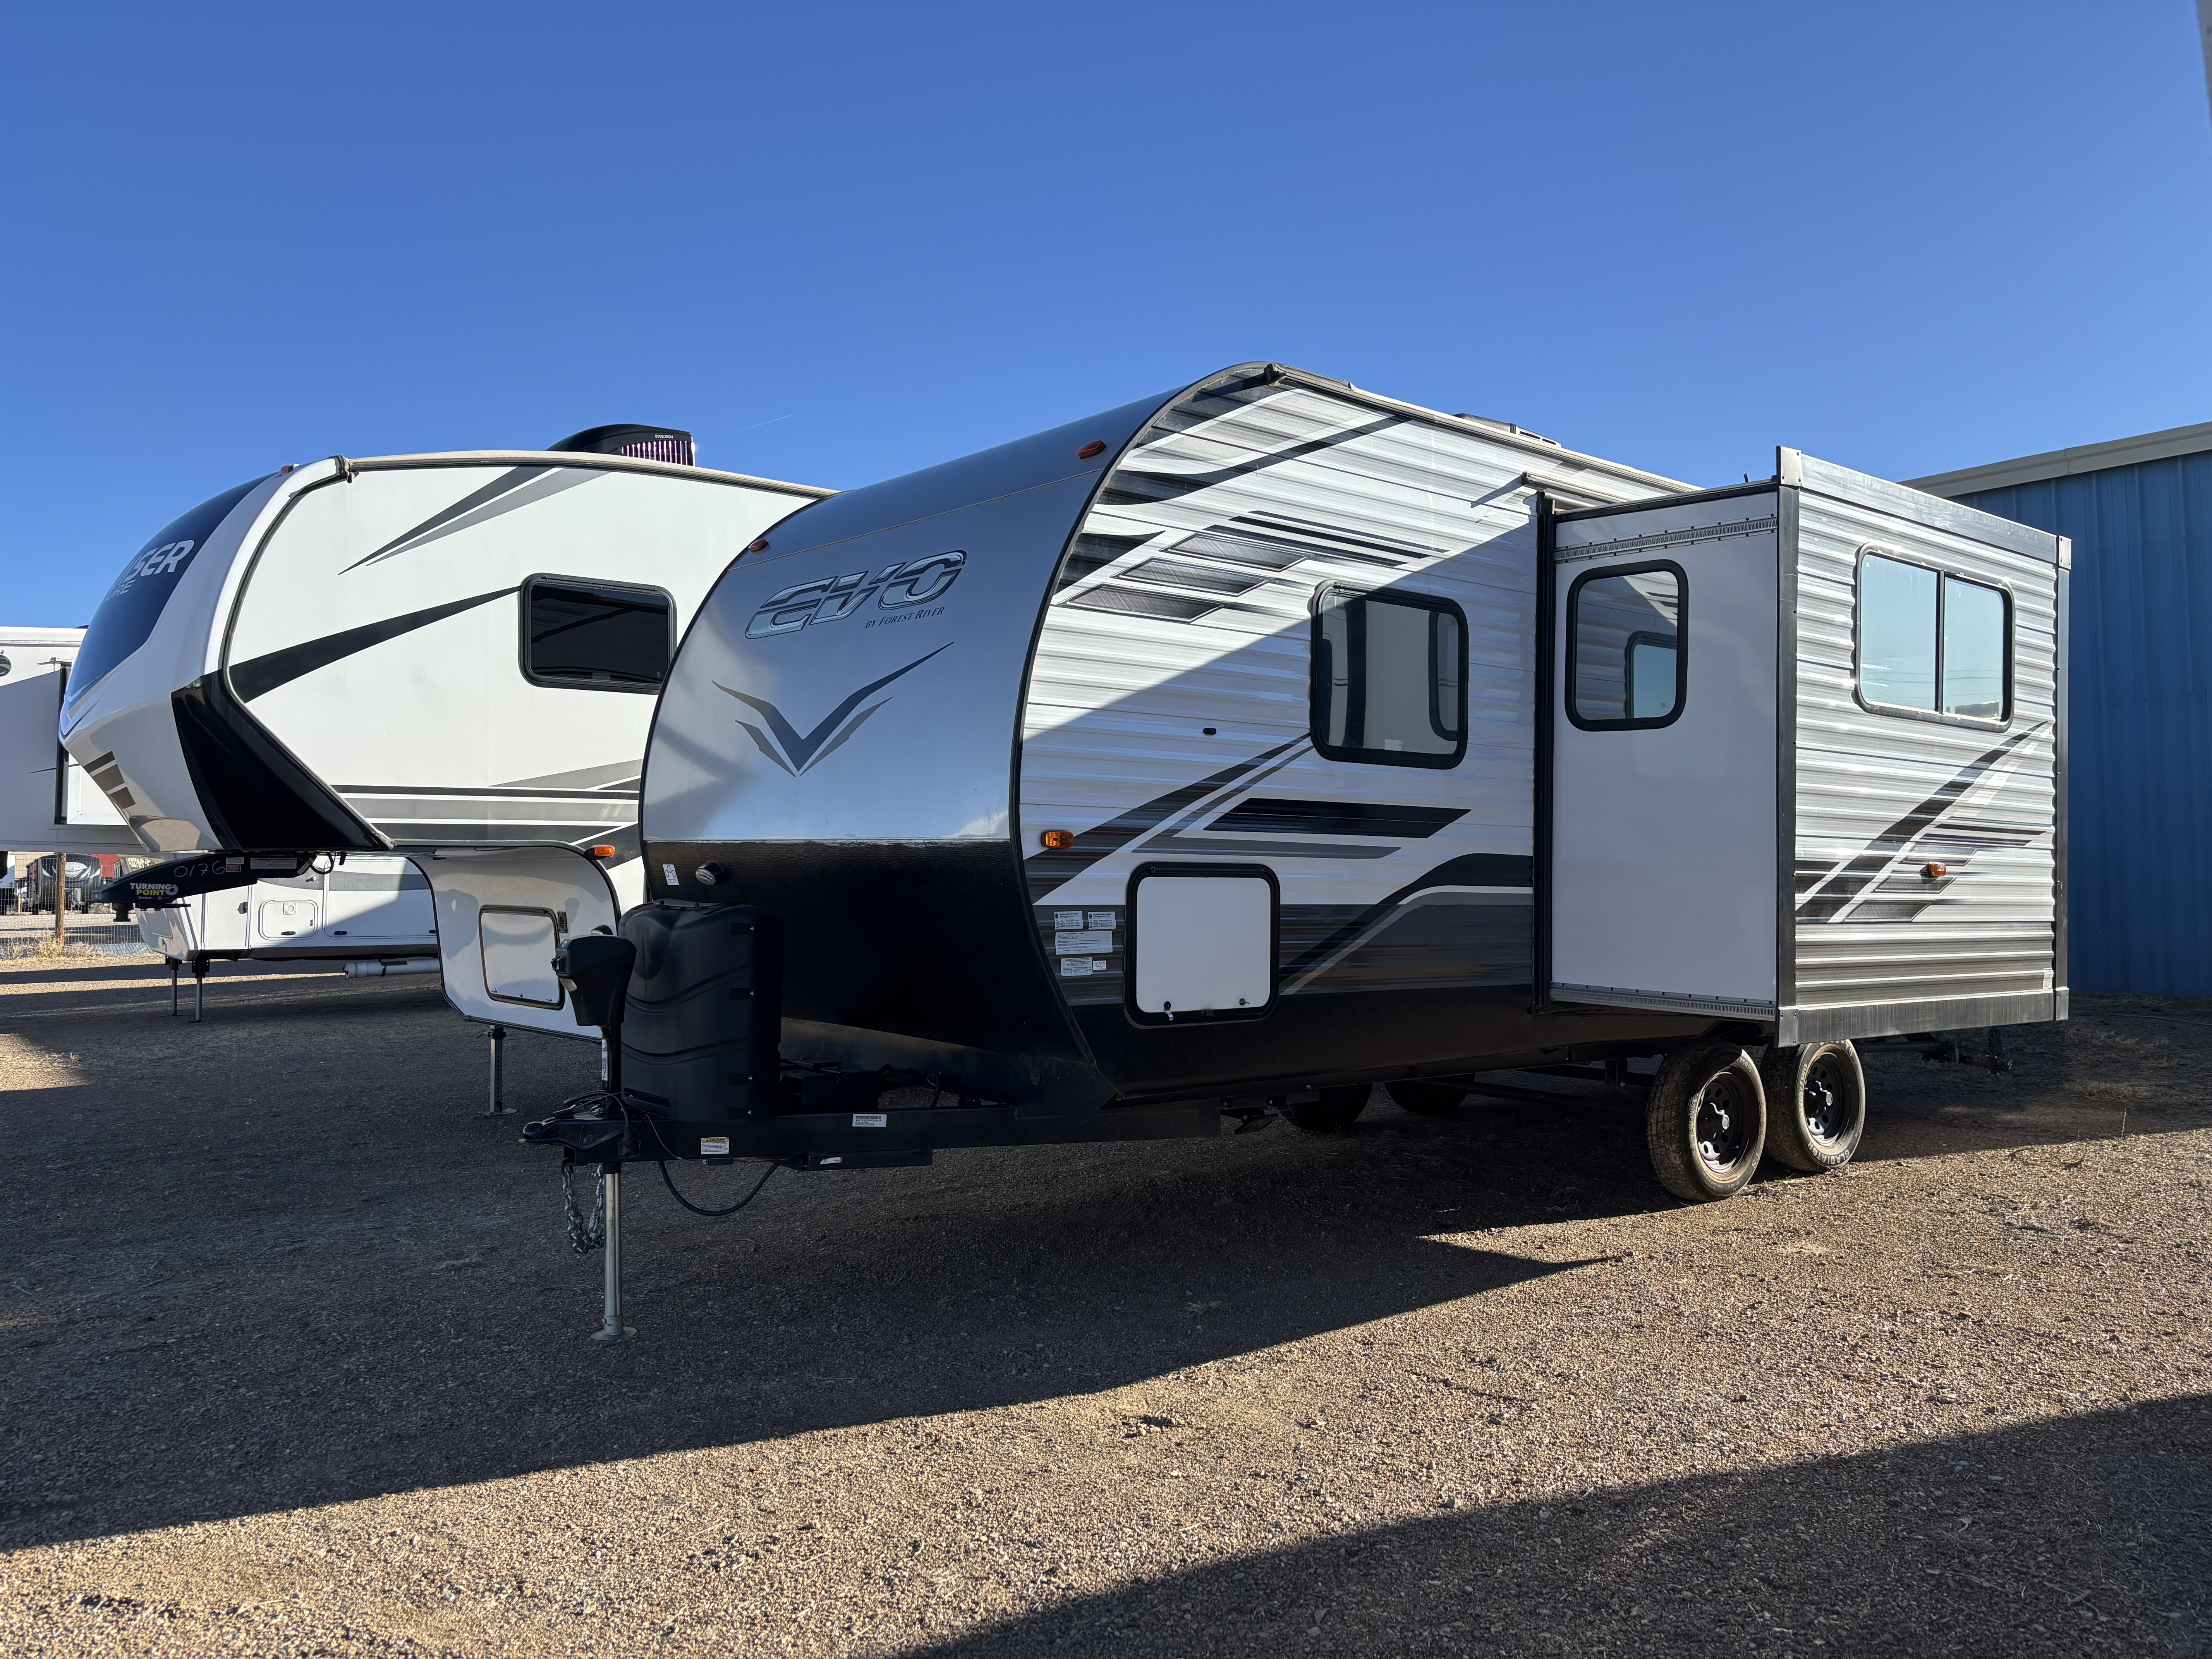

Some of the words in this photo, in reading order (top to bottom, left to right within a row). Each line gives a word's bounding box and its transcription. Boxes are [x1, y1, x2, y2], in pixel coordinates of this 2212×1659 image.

[745, 550, 967, 639] EVO
[865, 619, 878, 628] BY
[878, 612, 915, 626] FOREST
[915, 607, 945, 619] RIVER
[1808, 1140, 1850, 1164] GLADIATOR
